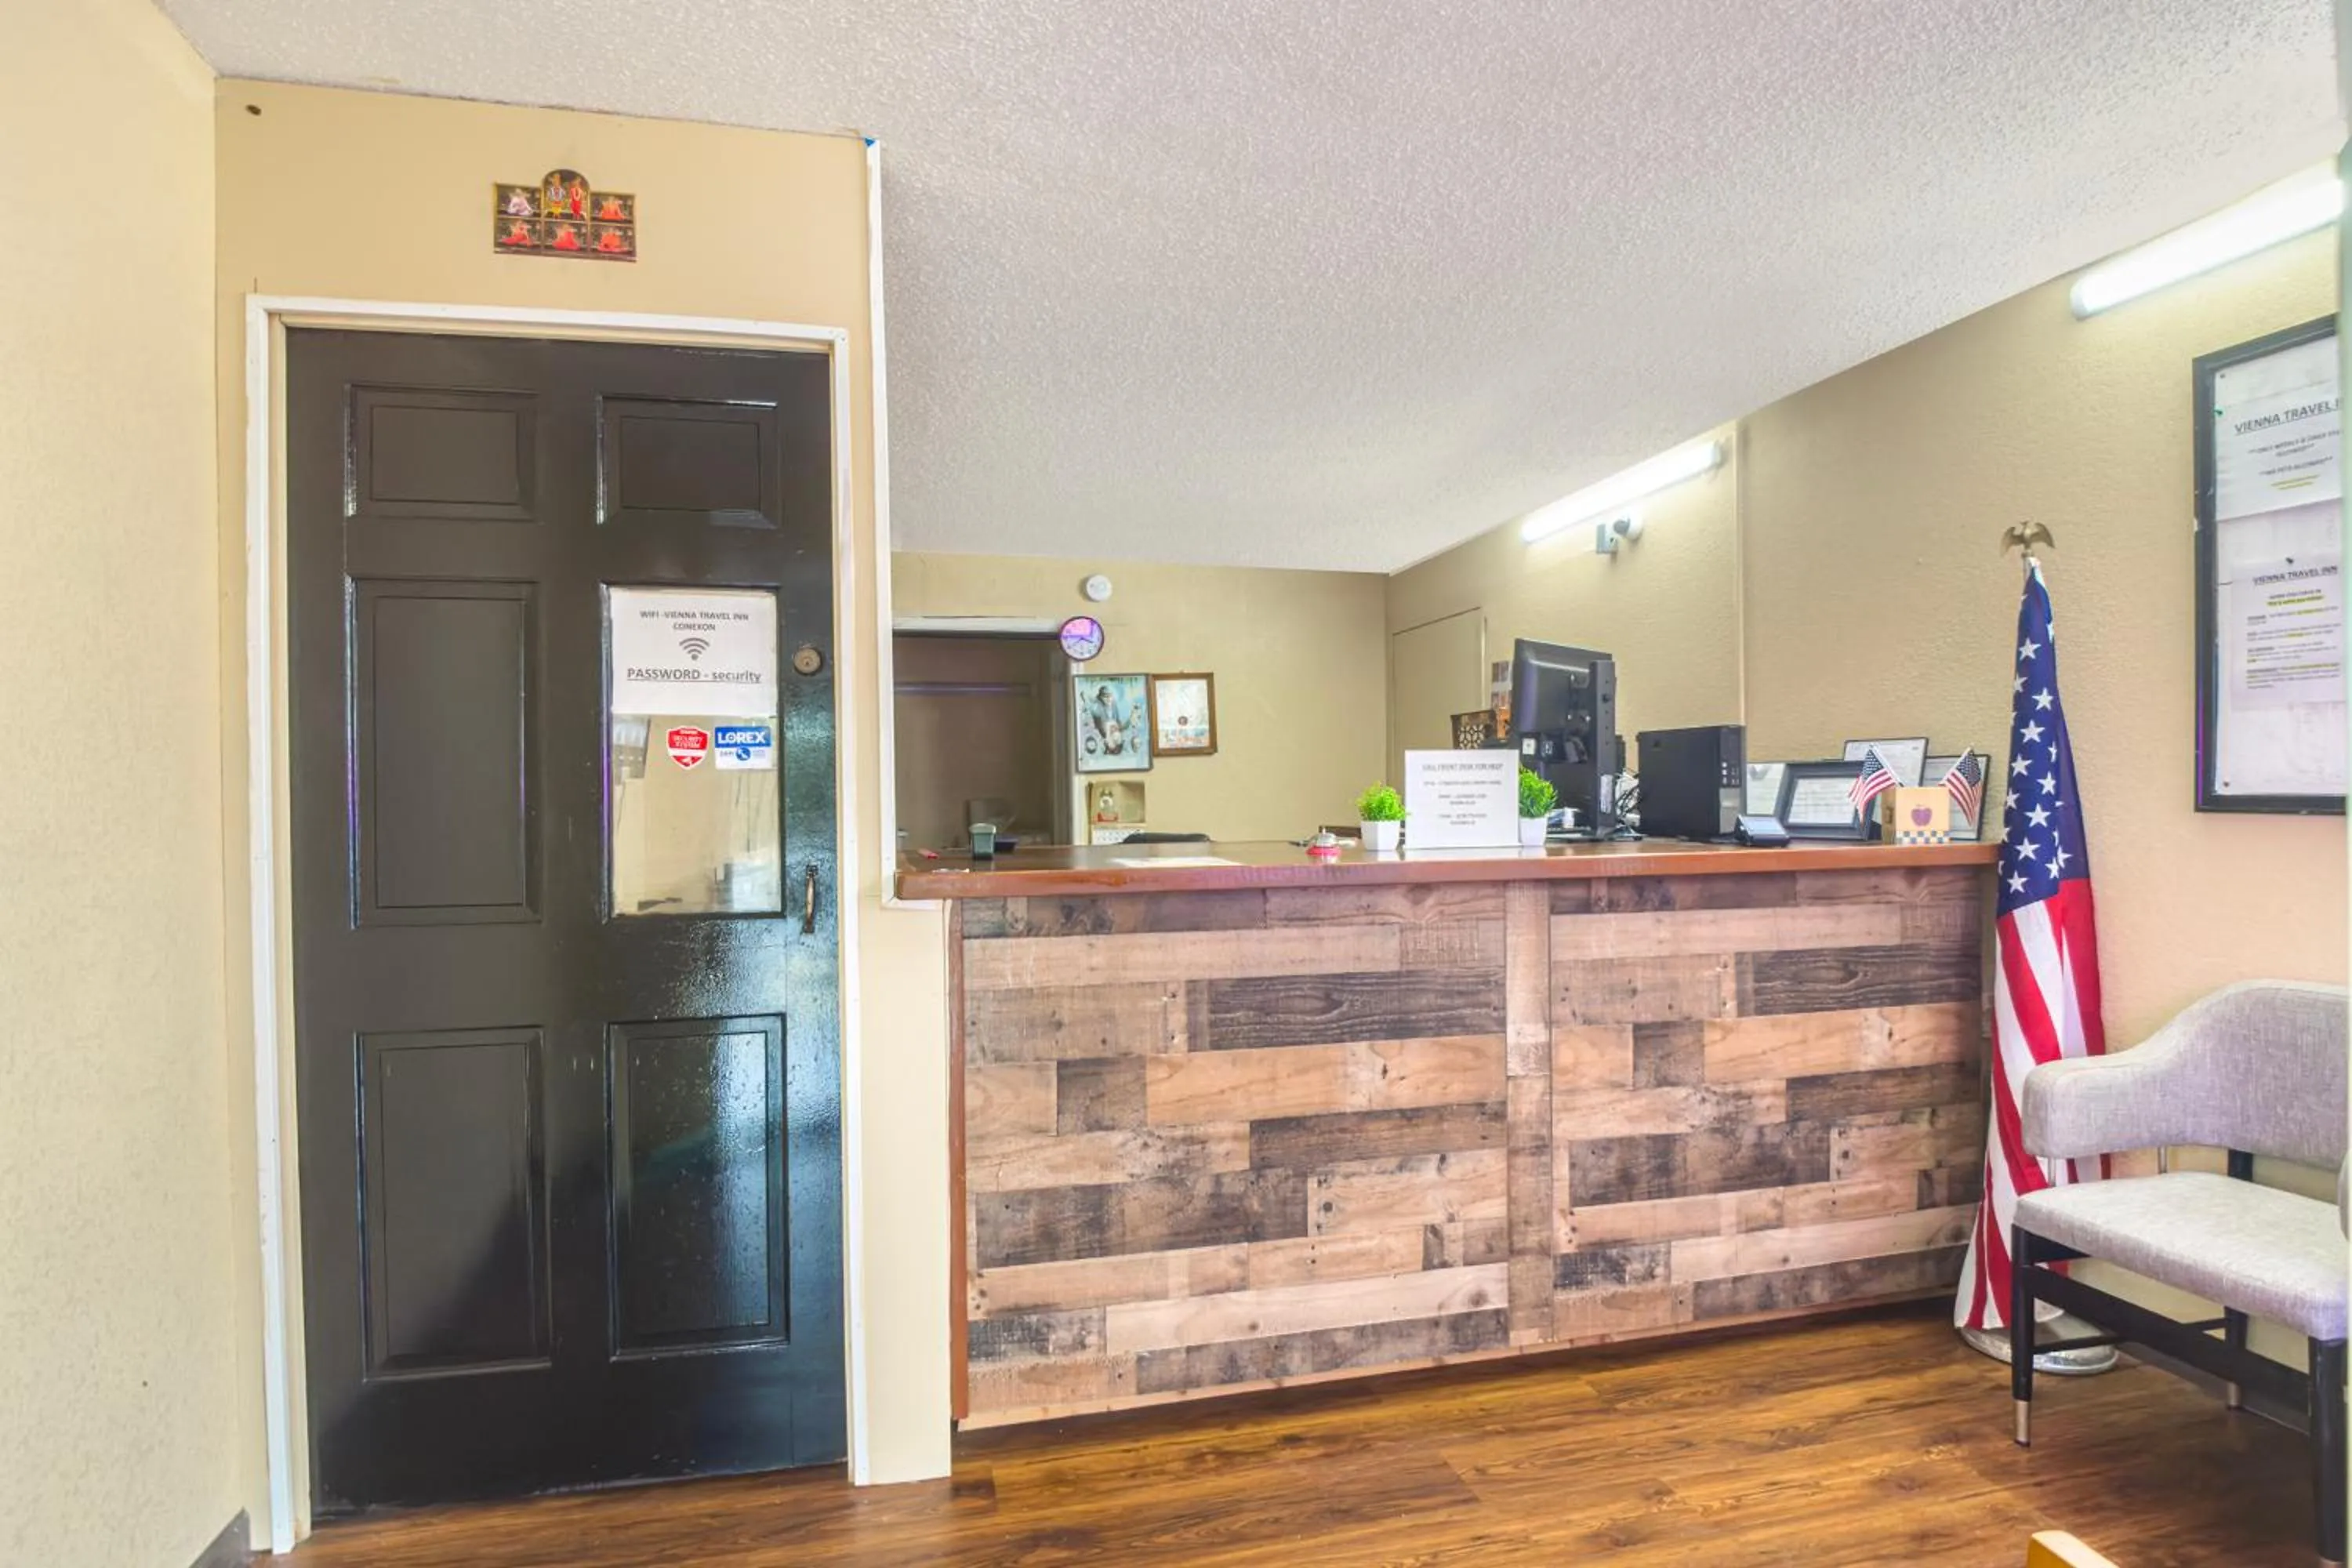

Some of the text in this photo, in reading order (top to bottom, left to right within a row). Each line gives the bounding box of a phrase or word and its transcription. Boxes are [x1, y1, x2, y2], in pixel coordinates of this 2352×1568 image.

[2234, 413, 2281, 433] VIENNA
[2283, 401, 2332, 421] TRAVEL
[2252, 565, 2338, 585] VIENNA TRAVEL INN
[639, 611, 659, 619] WIFI
[699, 612, 731, 620] TRAVEL
[733, 612, 749, 621] INN
[627, 667, 700, 680] PASSWORD
[712, 670, 761, 682] security
[717, 731, 765, 744] LOREX
